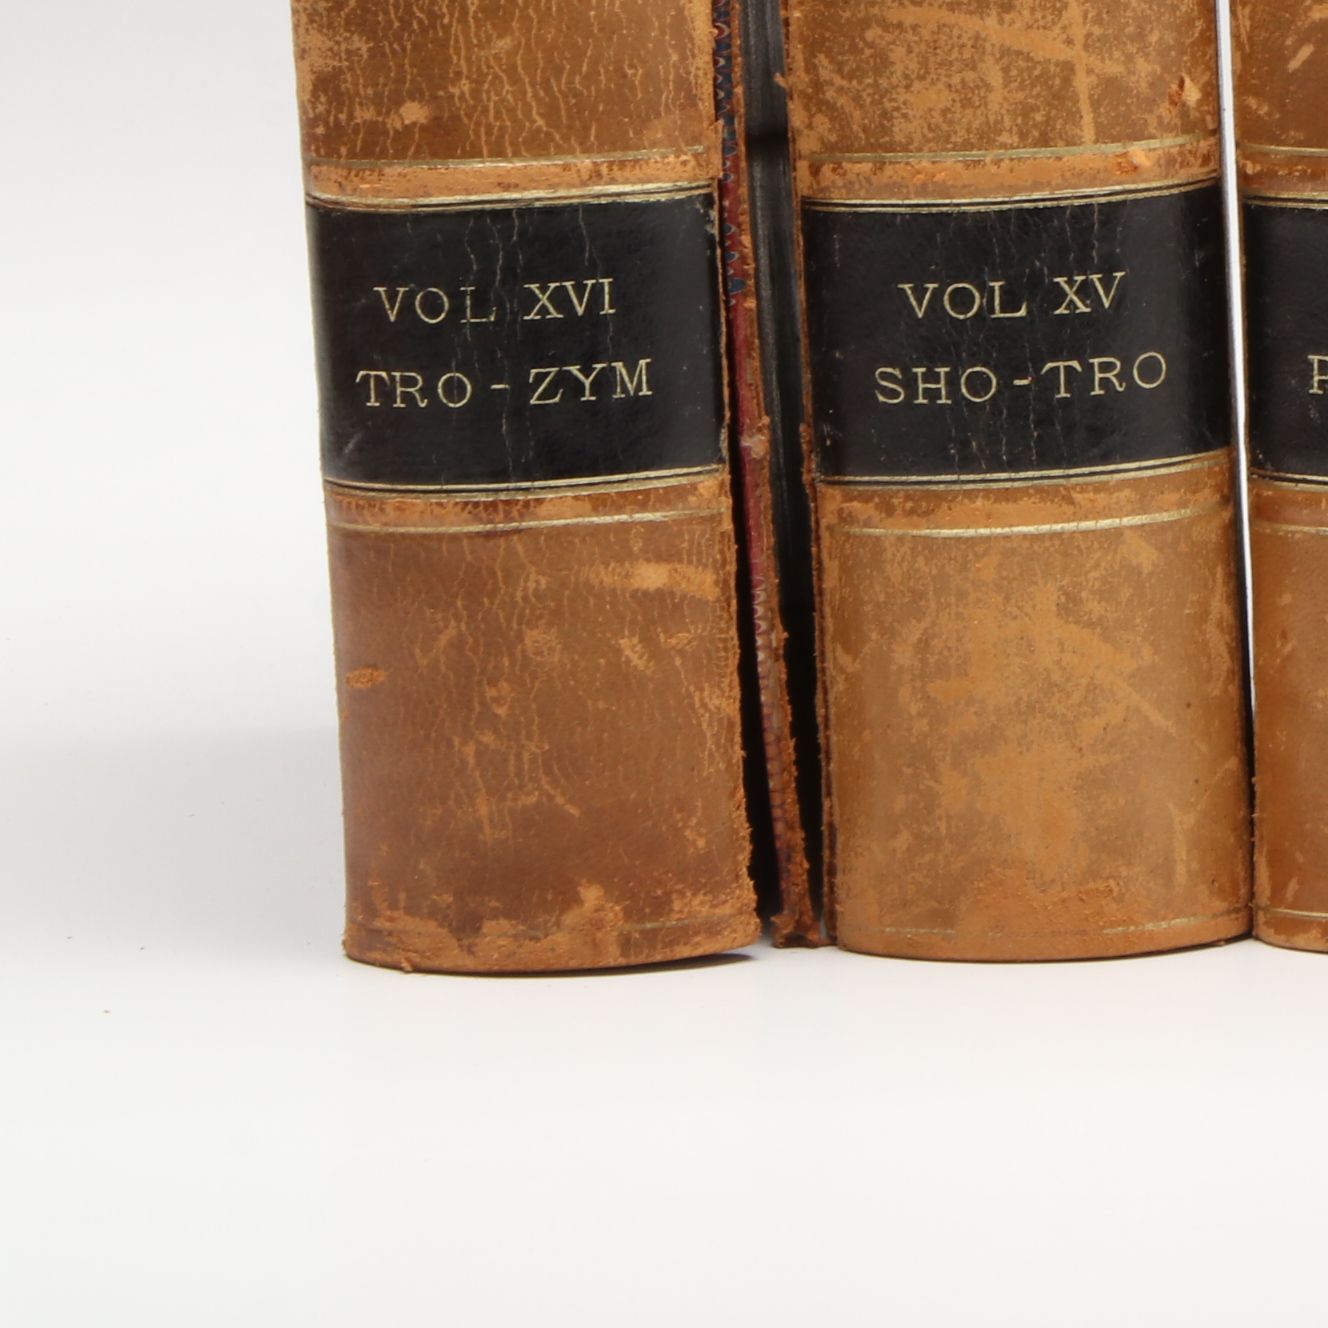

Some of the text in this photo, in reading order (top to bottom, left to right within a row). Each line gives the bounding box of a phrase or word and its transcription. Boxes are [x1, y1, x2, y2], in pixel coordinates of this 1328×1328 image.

[374, 278, 616, 323] VOL XVI
[898, 272, 1126, 319] VOL XV
